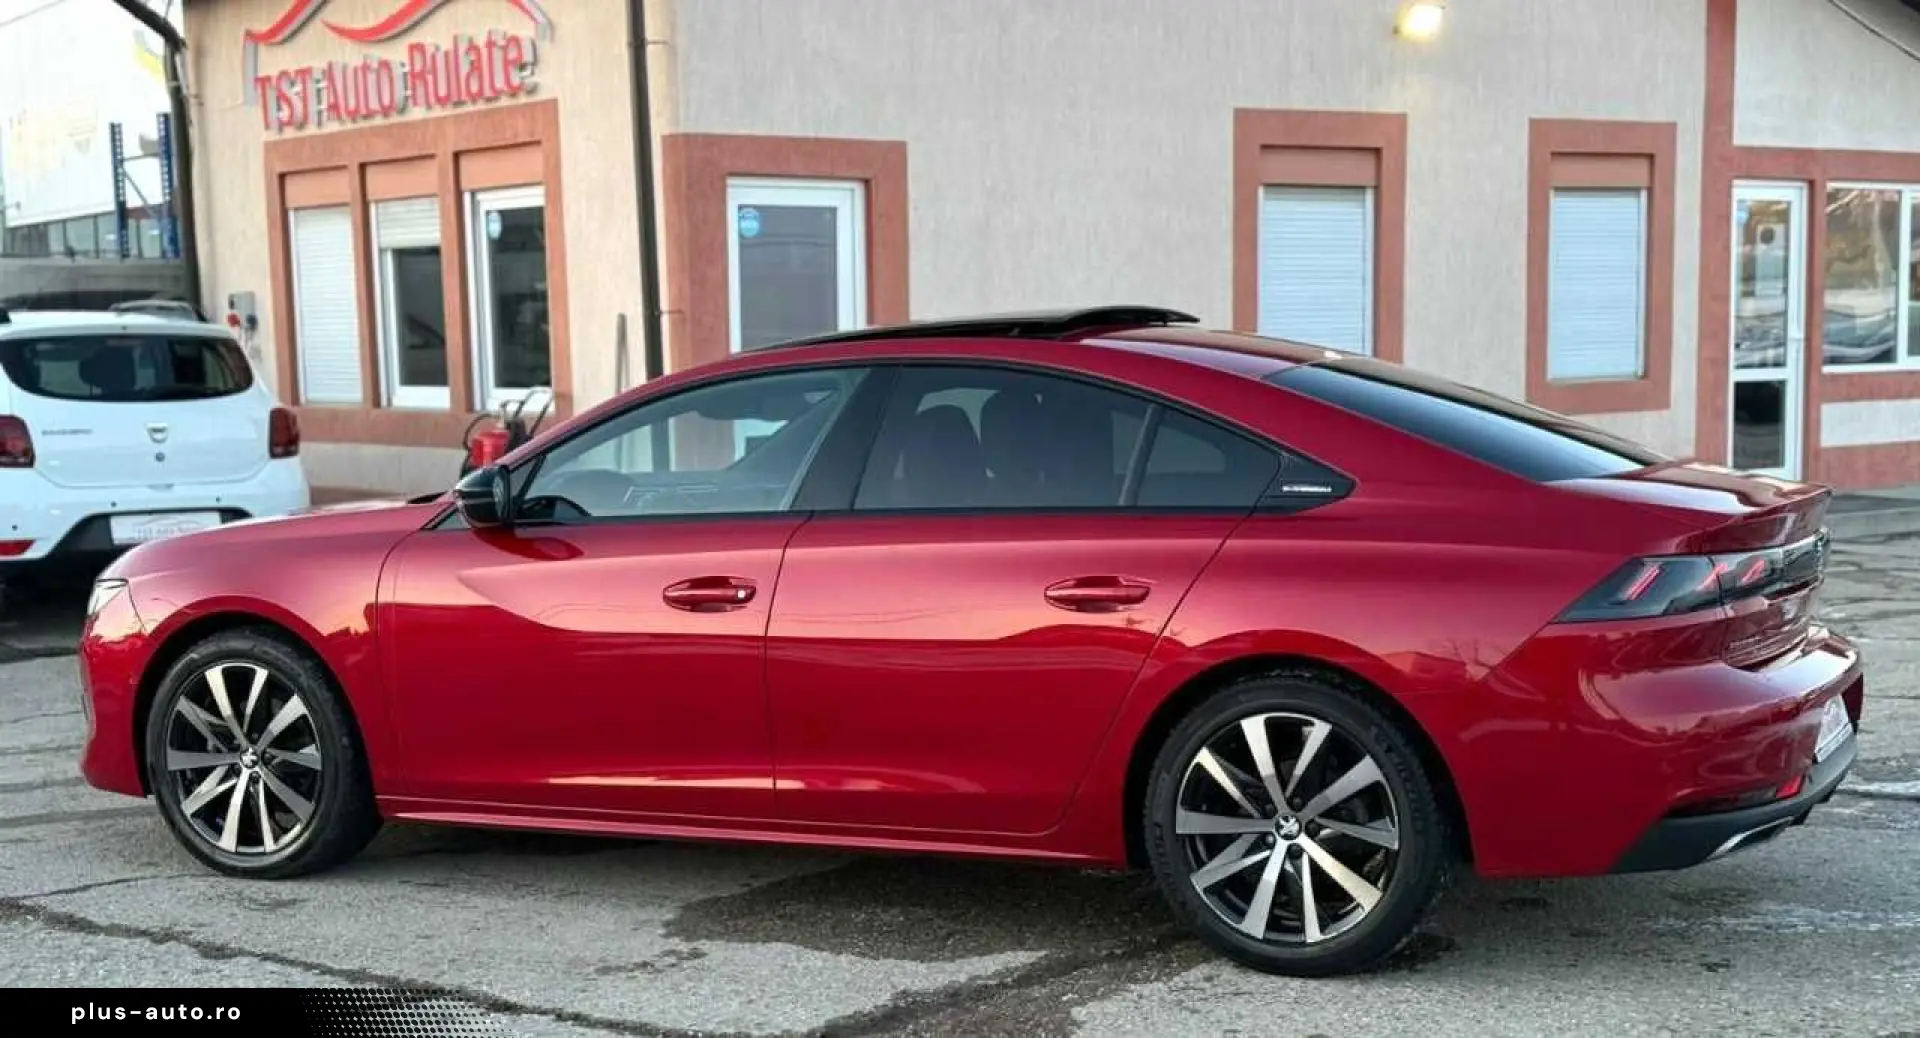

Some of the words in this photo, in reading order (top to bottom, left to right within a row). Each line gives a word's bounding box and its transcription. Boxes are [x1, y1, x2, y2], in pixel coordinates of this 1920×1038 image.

[254, 67, 313, 131] TST
[325, 58, 397, 121] Auto
[407, 33, 527, 109] Rulate
